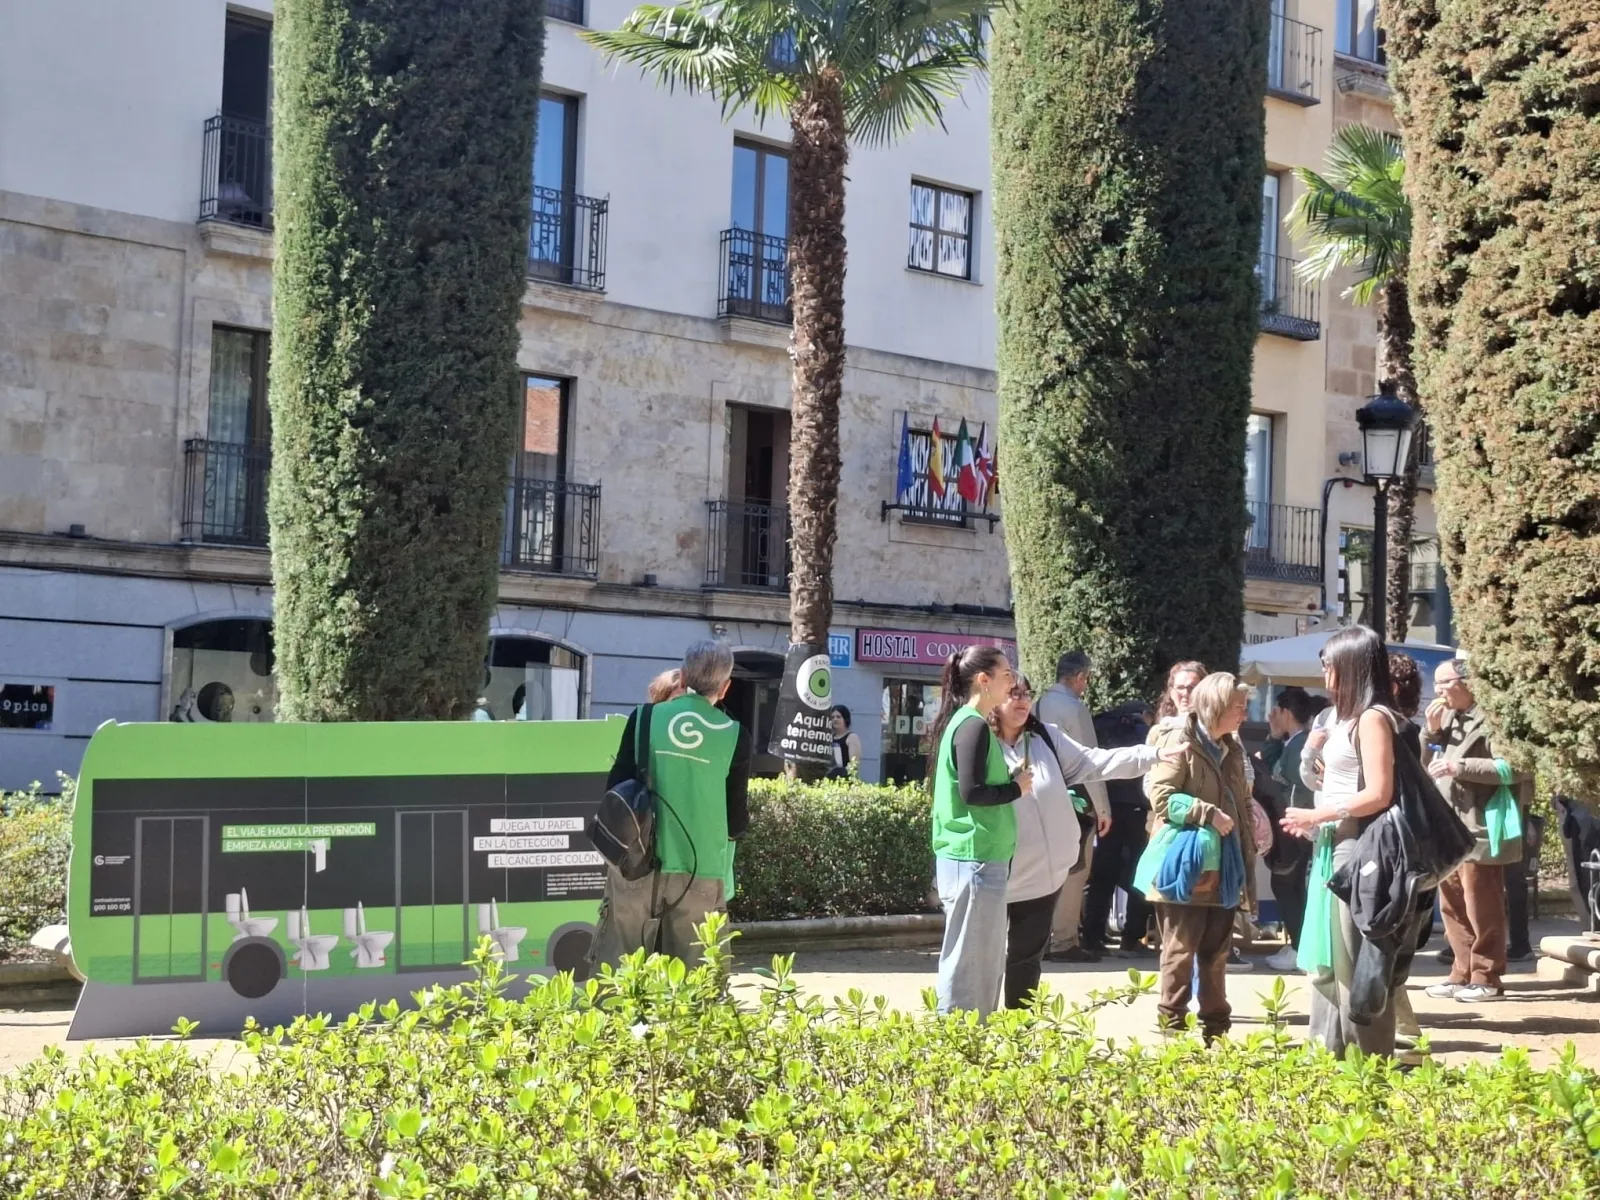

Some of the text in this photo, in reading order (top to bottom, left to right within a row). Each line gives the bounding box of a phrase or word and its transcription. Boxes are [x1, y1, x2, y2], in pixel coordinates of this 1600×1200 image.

[1243, 632, 1285, 645] LIBERT
[862, 633, 918, 659] HOSTAL
[793, 711, 824, 729] Aquí
[780, 738, 833, 756] en cuen
[227, 823, 372, 837] EL VIAJE HACIA LA PREVENCIÓN
[499, 820, 577, 832] JUEGA TU PAPEL
[226, 839, 292, 851] EMPIEZA AQUÍ
[478, 839, 492, 849] EN
[494, 838, 508, 848] LA
[493, 856, 505, 866] EL
[549, 854, 563, 864] DE
